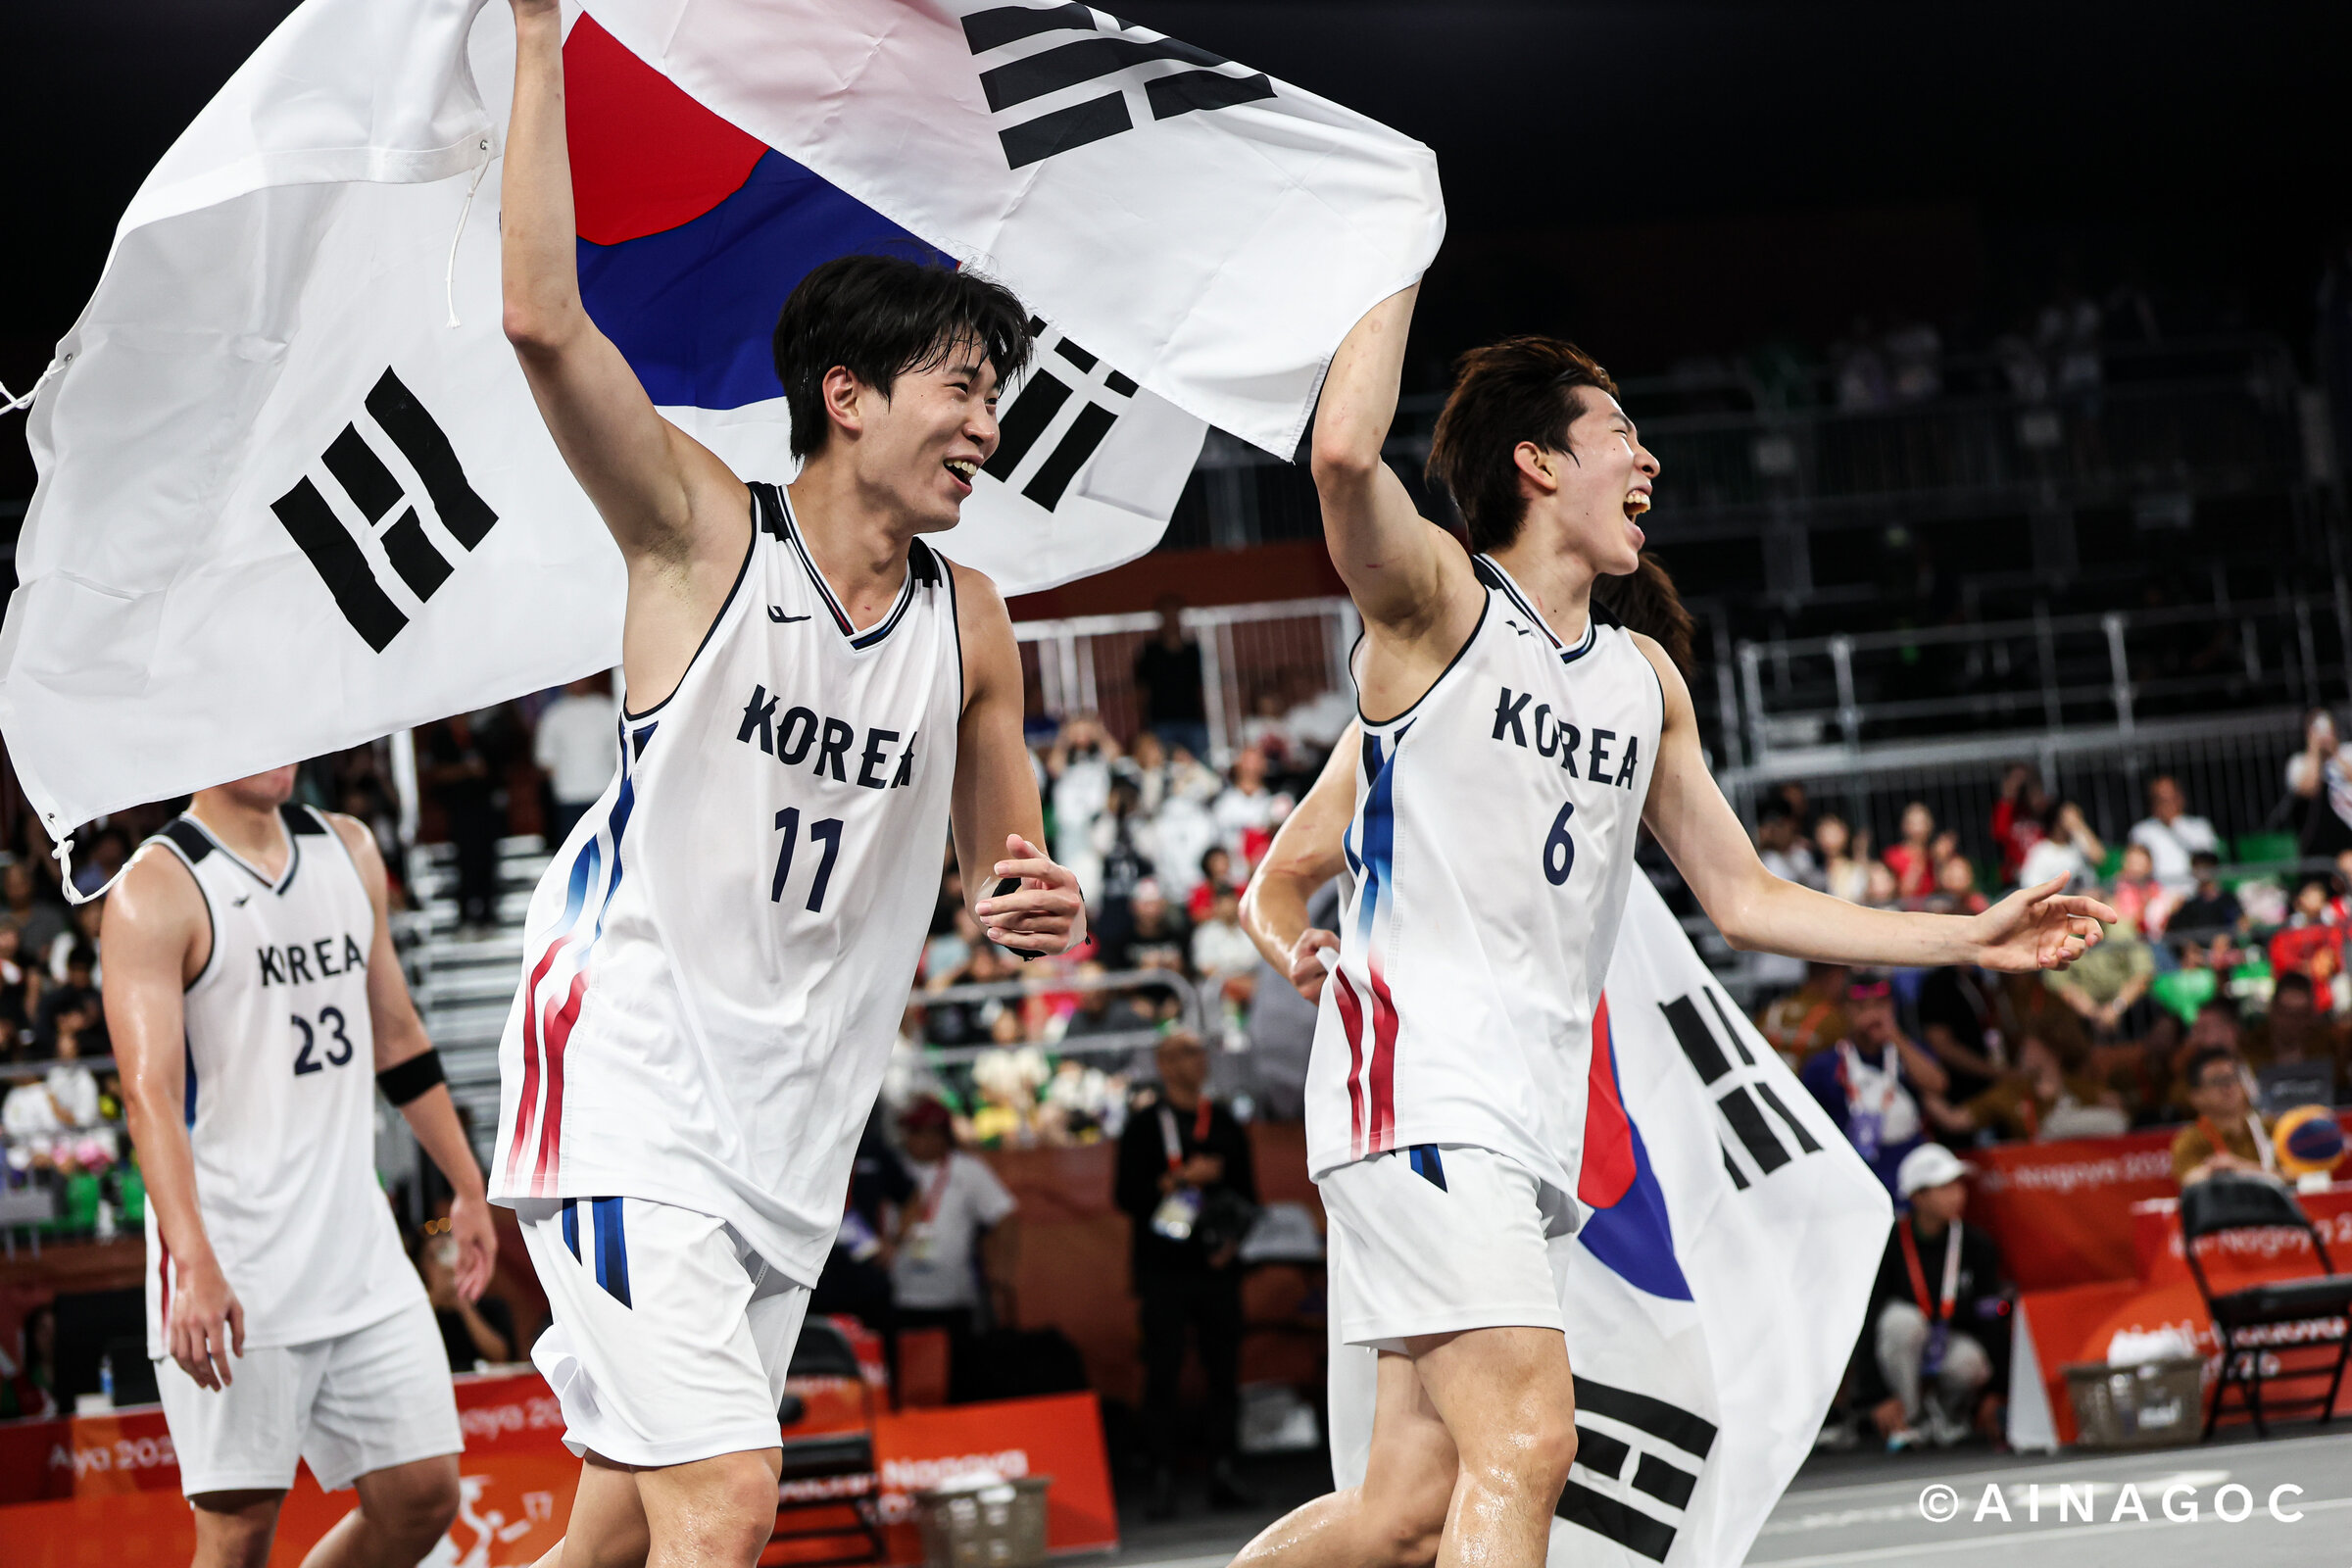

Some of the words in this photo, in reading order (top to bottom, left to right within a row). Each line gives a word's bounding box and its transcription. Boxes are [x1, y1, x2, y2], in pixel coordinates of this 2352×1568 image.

[736, 684, 915, 790] KOREA
[1492, 686, 1638, 790] KOREA
[770, 806, 845, 913] 11
[1543, 801, 1575, 886] 6
[257, 933, 367, 988] KREA
[290, 1005, 353, 1076] 23
